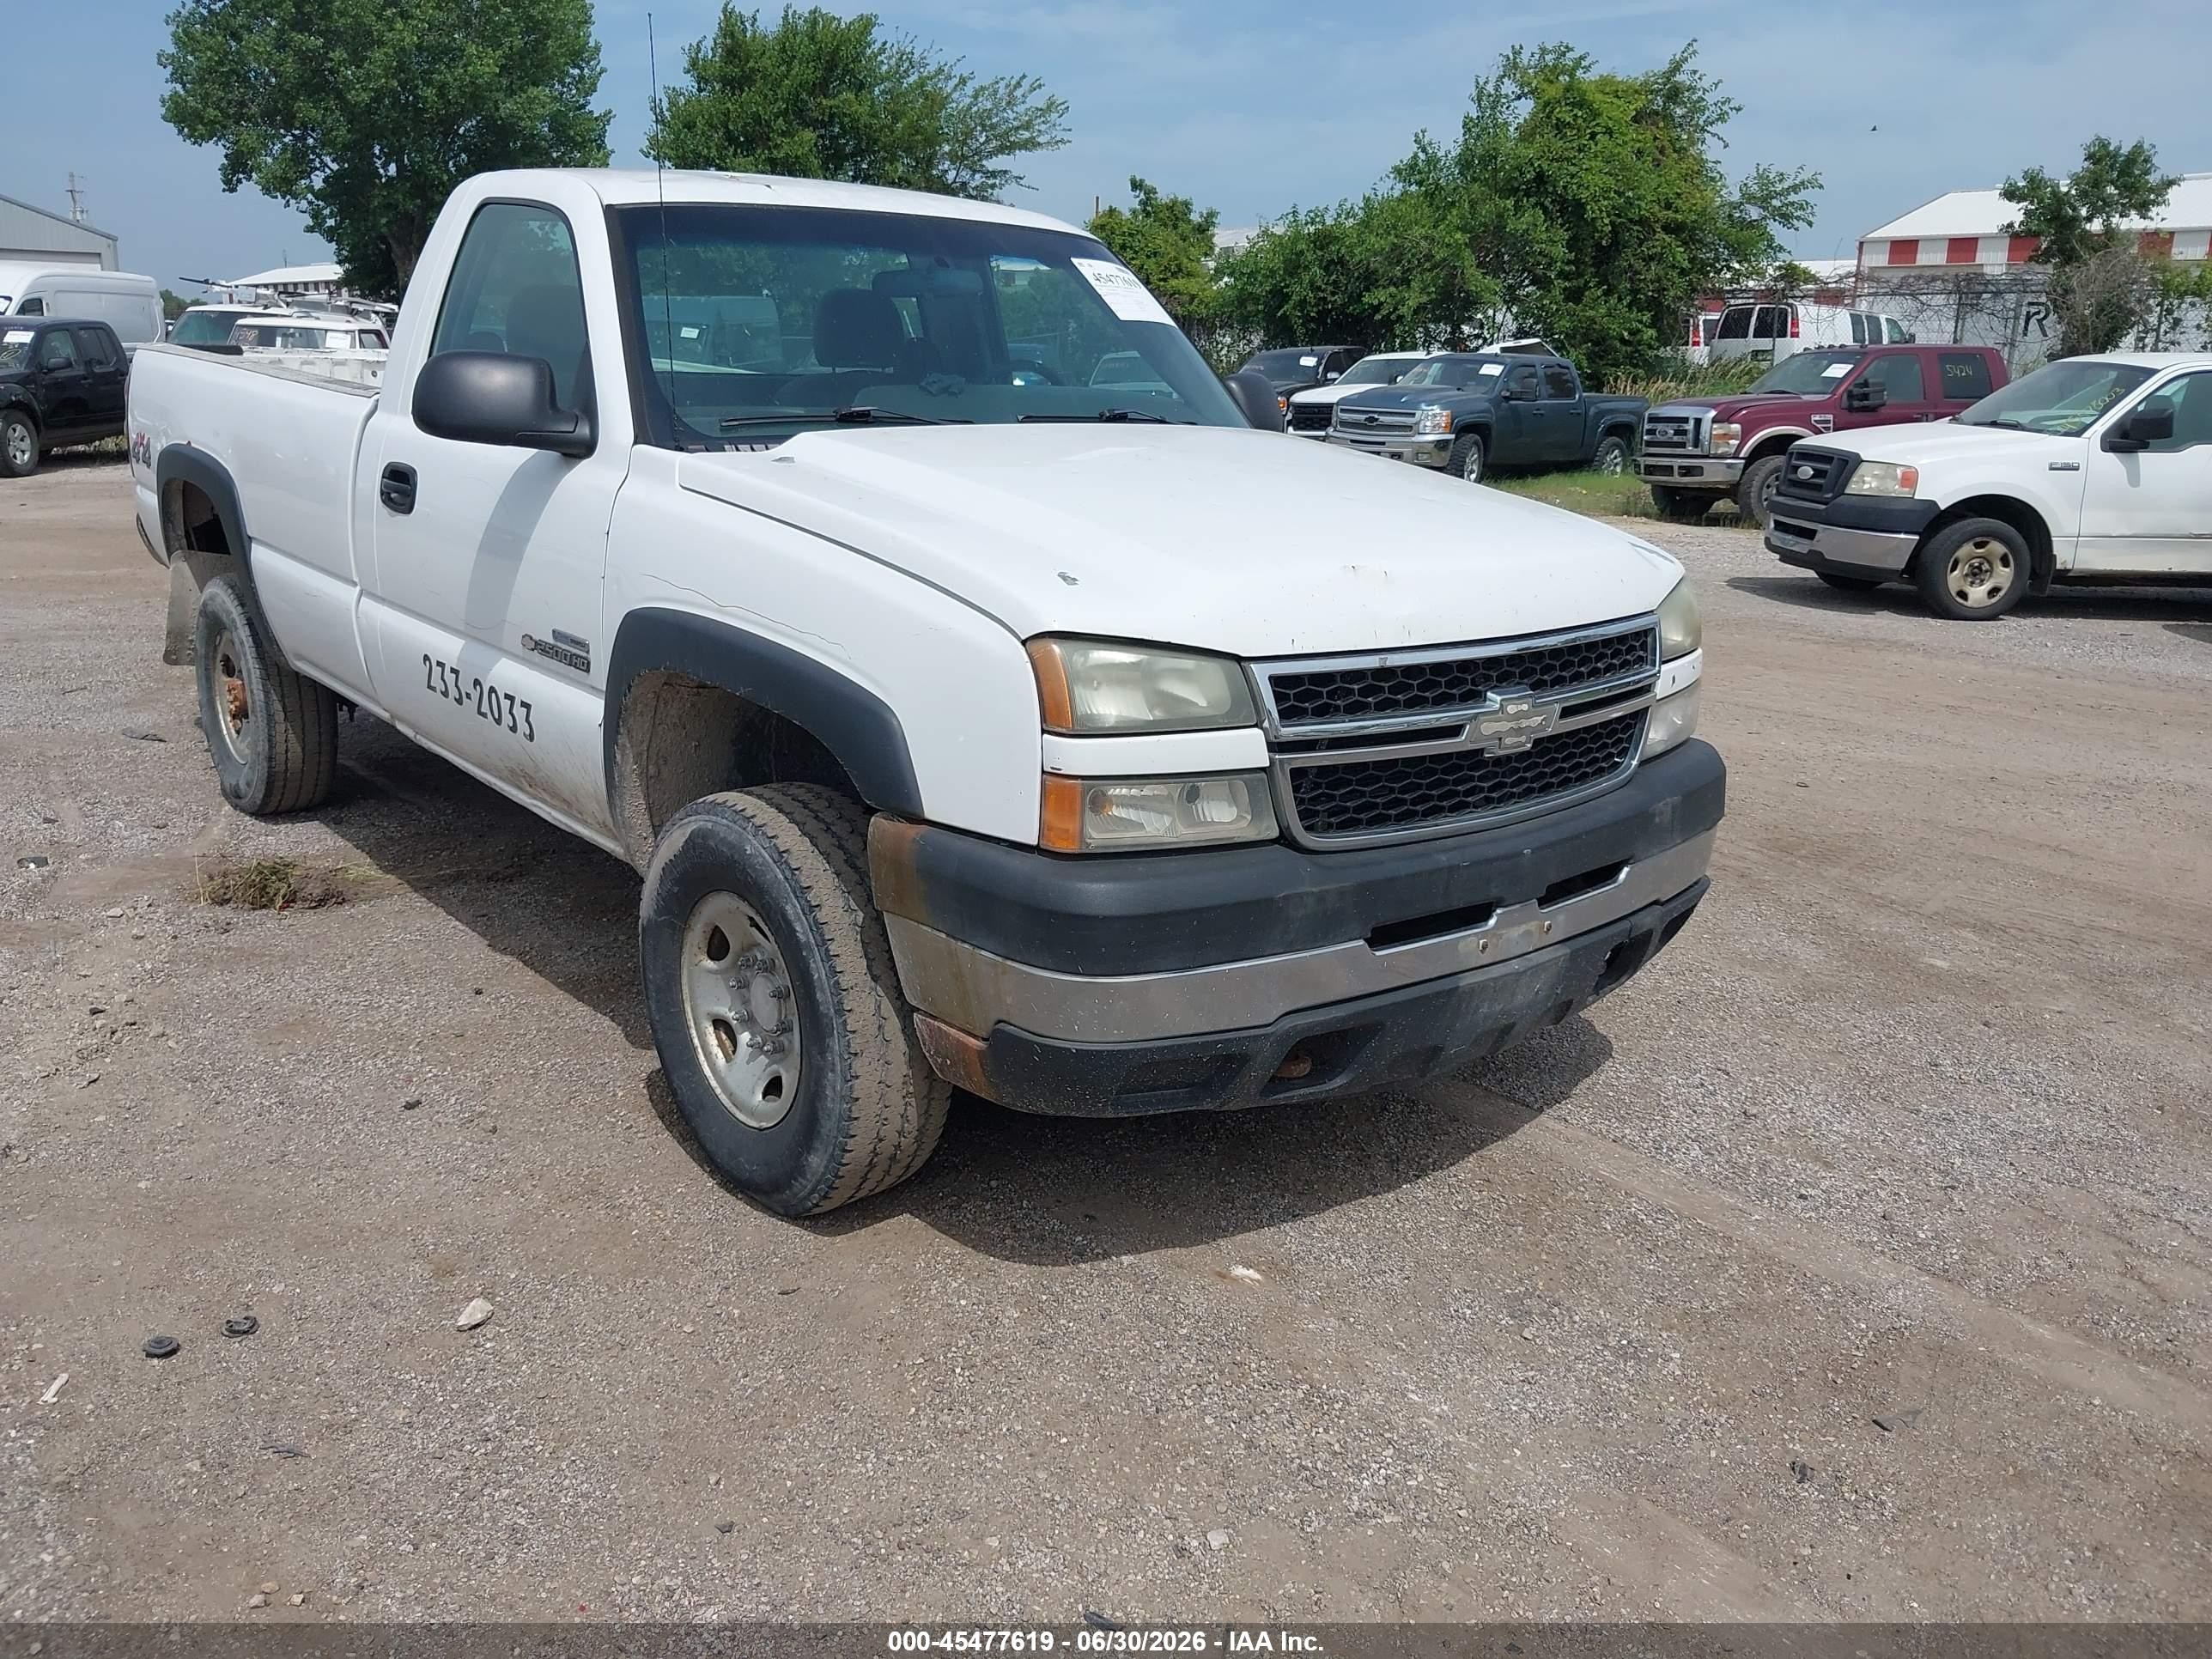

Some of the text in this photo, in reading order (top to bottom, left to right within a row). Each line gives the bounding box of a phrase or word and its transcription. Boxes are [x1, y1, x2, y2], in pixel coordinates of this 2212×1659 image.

[537, 641, 571, 665] 2500
[572, 653, 590, 672] HD
[423, 653, 535, 742] 233-2033
